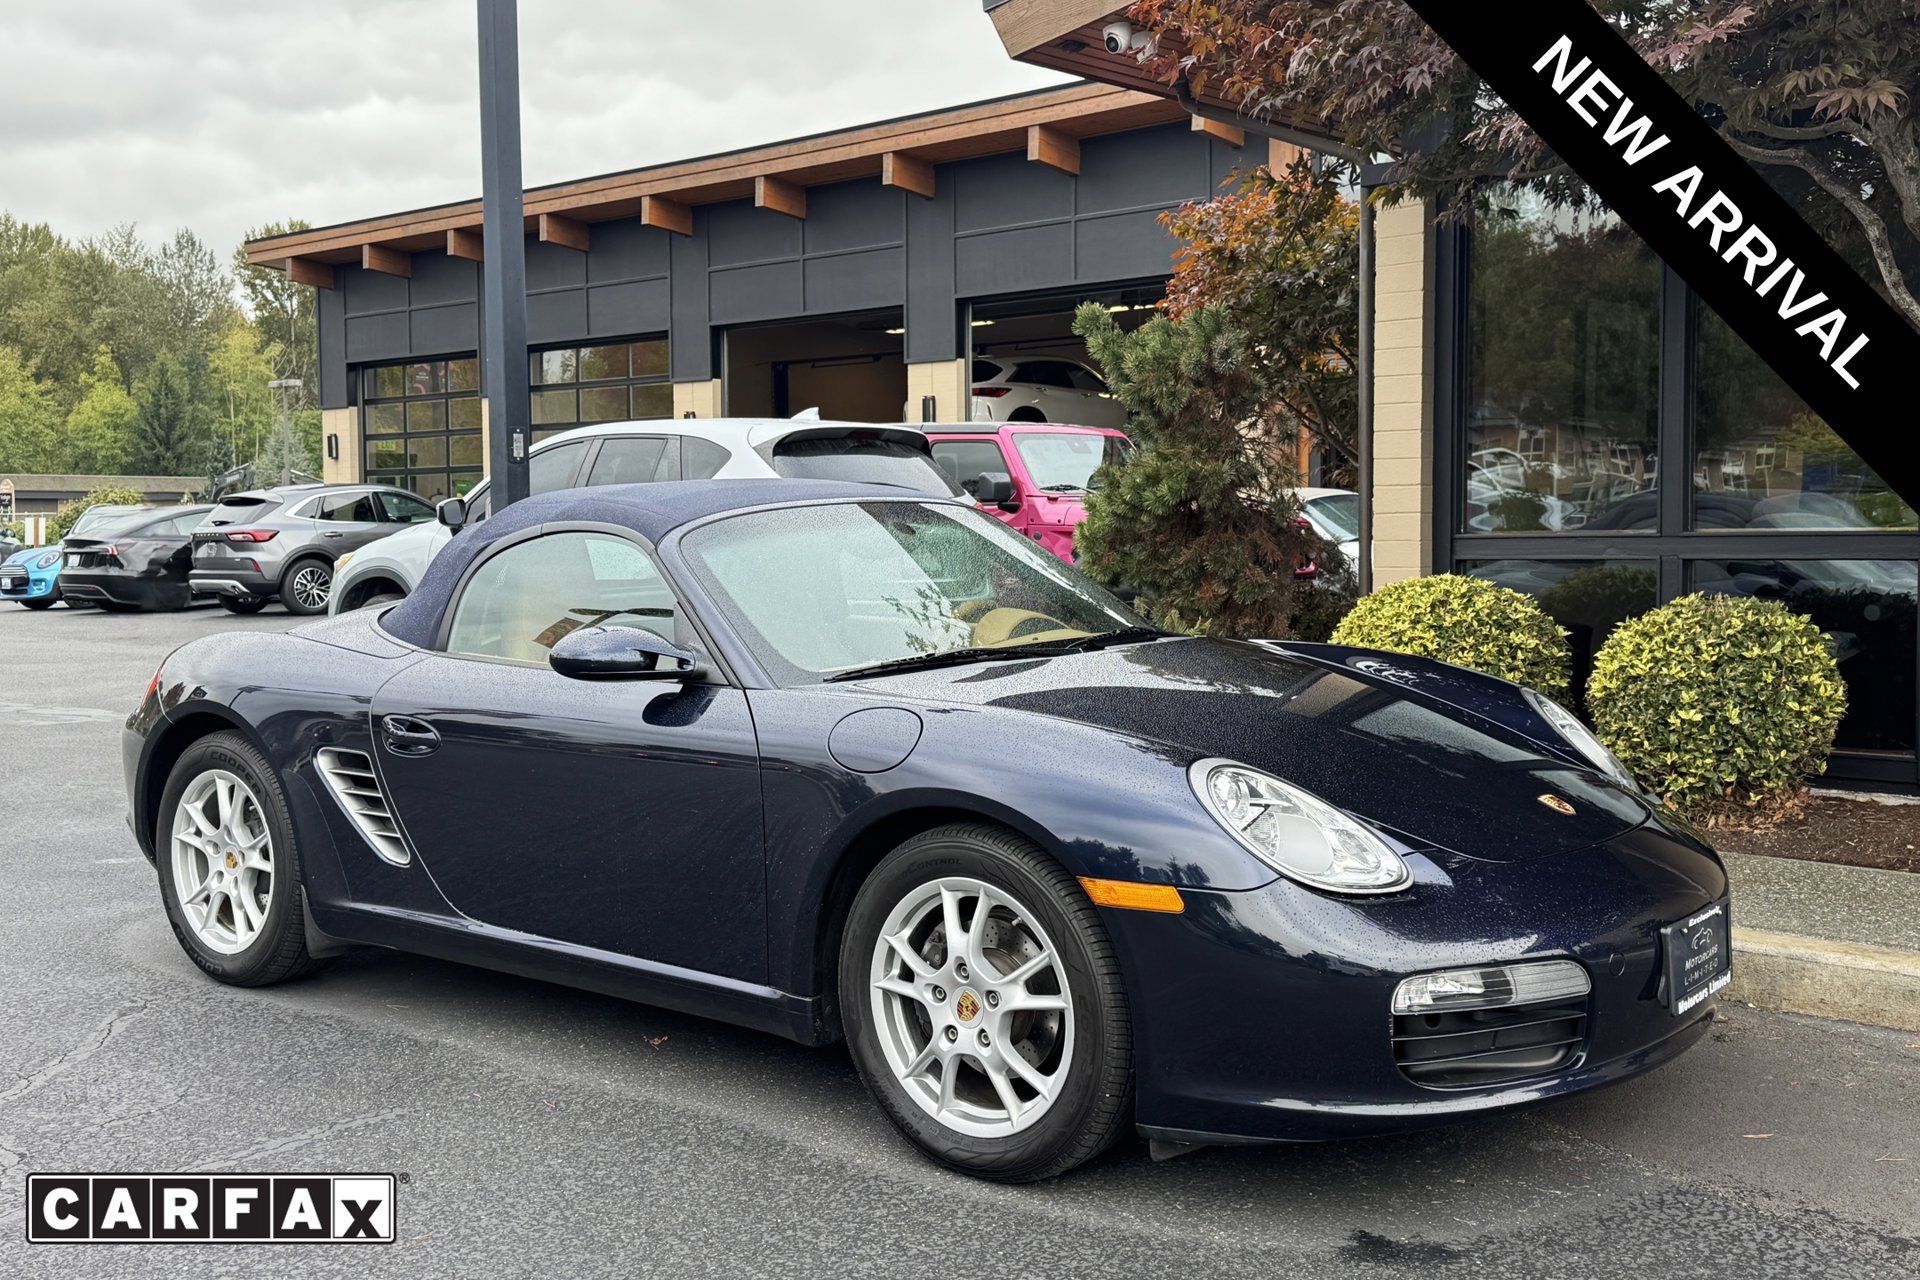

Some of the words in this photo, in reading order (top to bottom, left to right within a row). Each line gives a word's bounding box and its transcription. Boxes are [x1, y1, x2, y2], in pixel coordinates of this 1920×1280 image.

[210, 751, 262, 795] COOPER
[1684, 944, 1718, 971] MOTORCARS
[1678, 987, 1709, 1015] Motorcars
[1709, 970, 1731, 995] Limited
